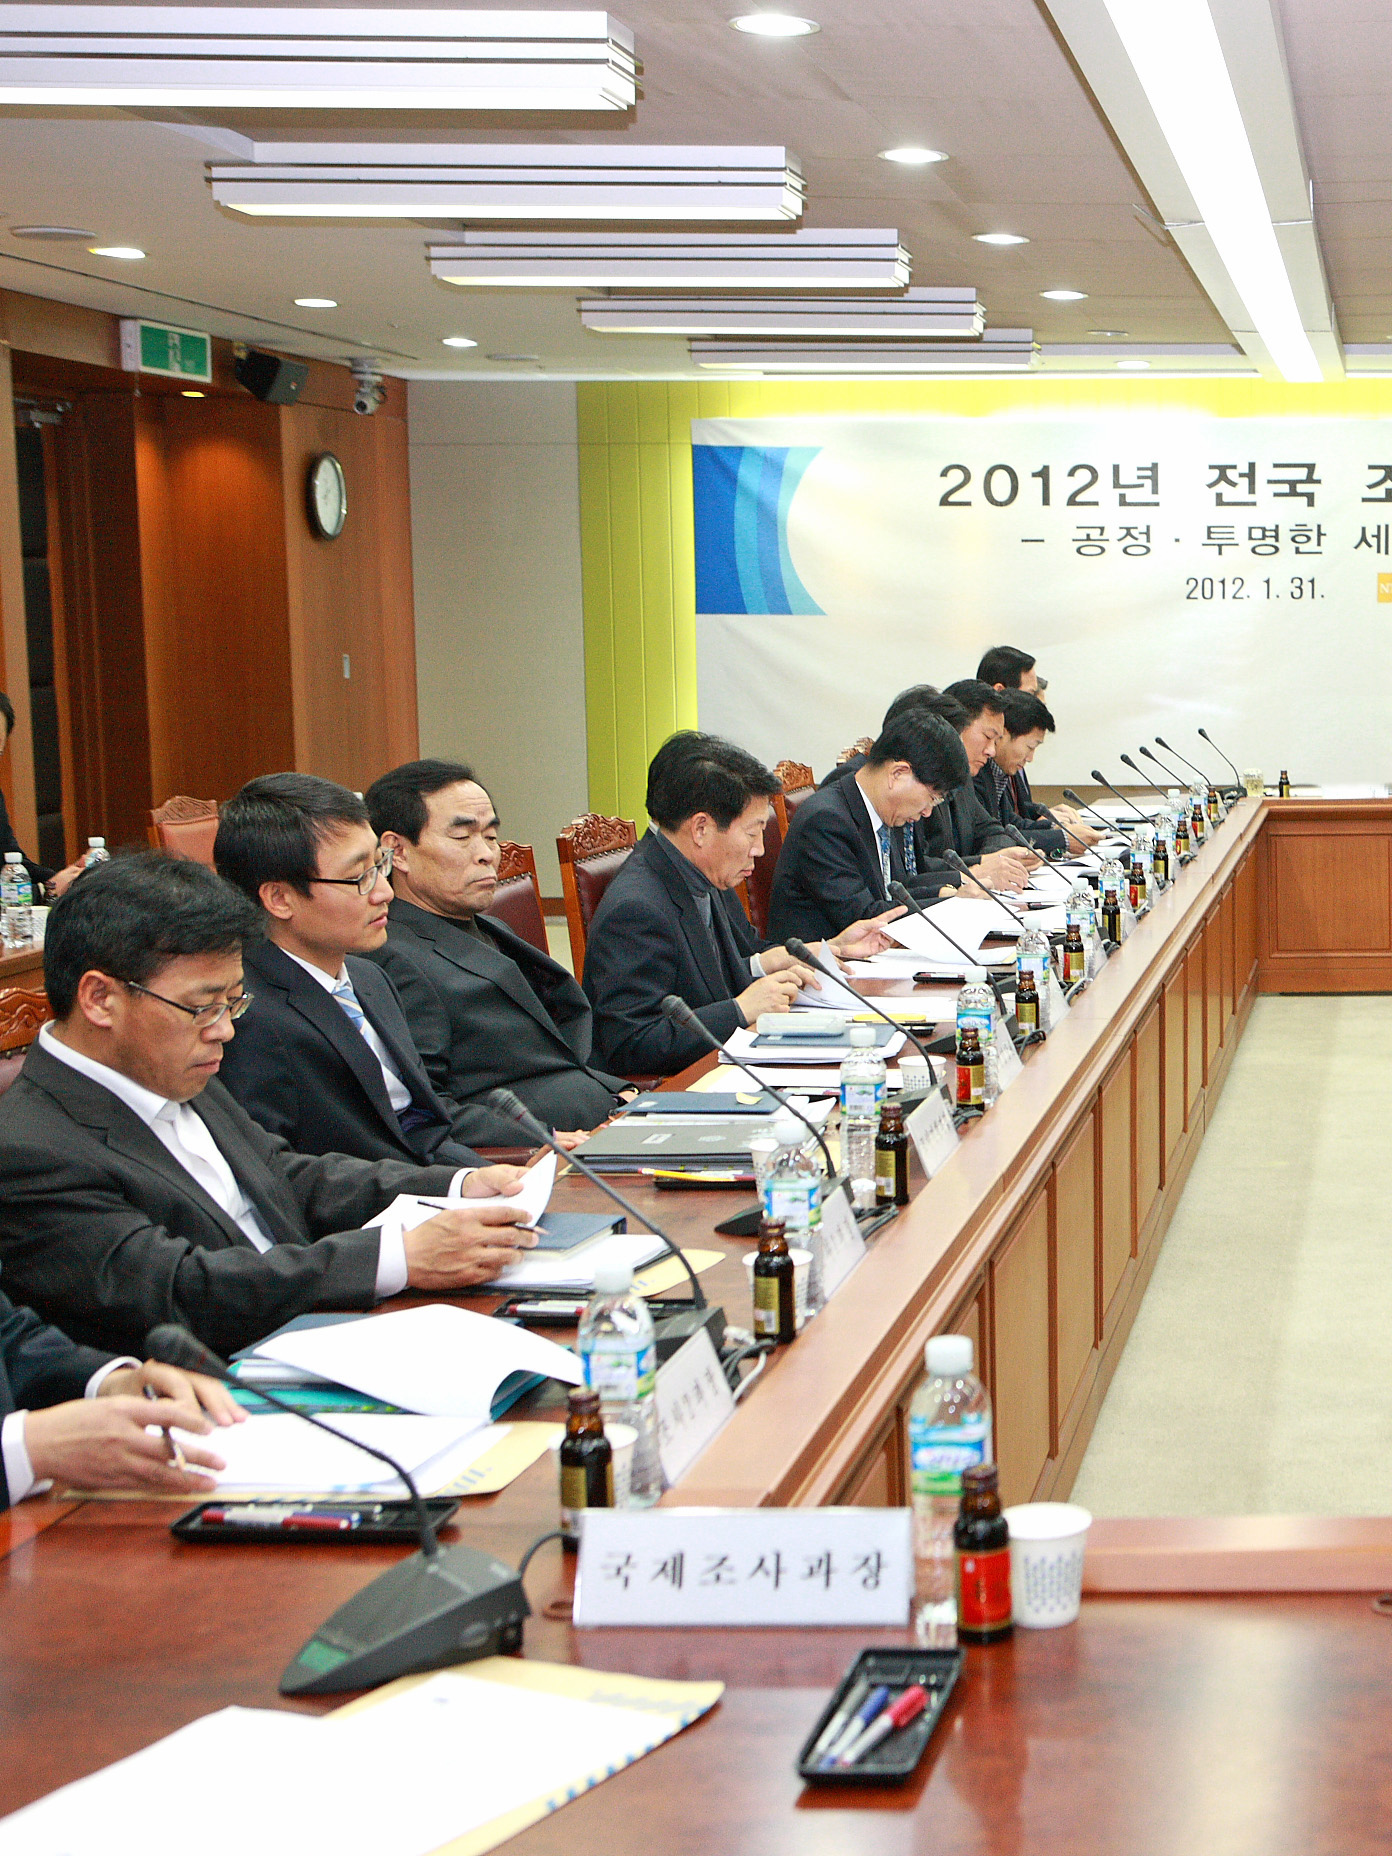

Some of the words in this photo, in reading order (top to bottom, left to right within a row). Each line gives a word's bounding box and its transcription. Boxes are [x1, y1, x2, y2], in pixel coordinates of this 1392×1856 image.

[938, 461, 1161, 508] 2012년
[1205, 461, 1323, 508] 전국
[1071, 524, 1152, 557] 공정
[1201, 523, 1328, 557] 투명한
[1185, 576, 1251, 601] 2012.
[1262, 576, 1280, 601] 1.
[1289, 576, 1325, 601] 31.
[601, 1549, 890, 1591] 국제조사과장
